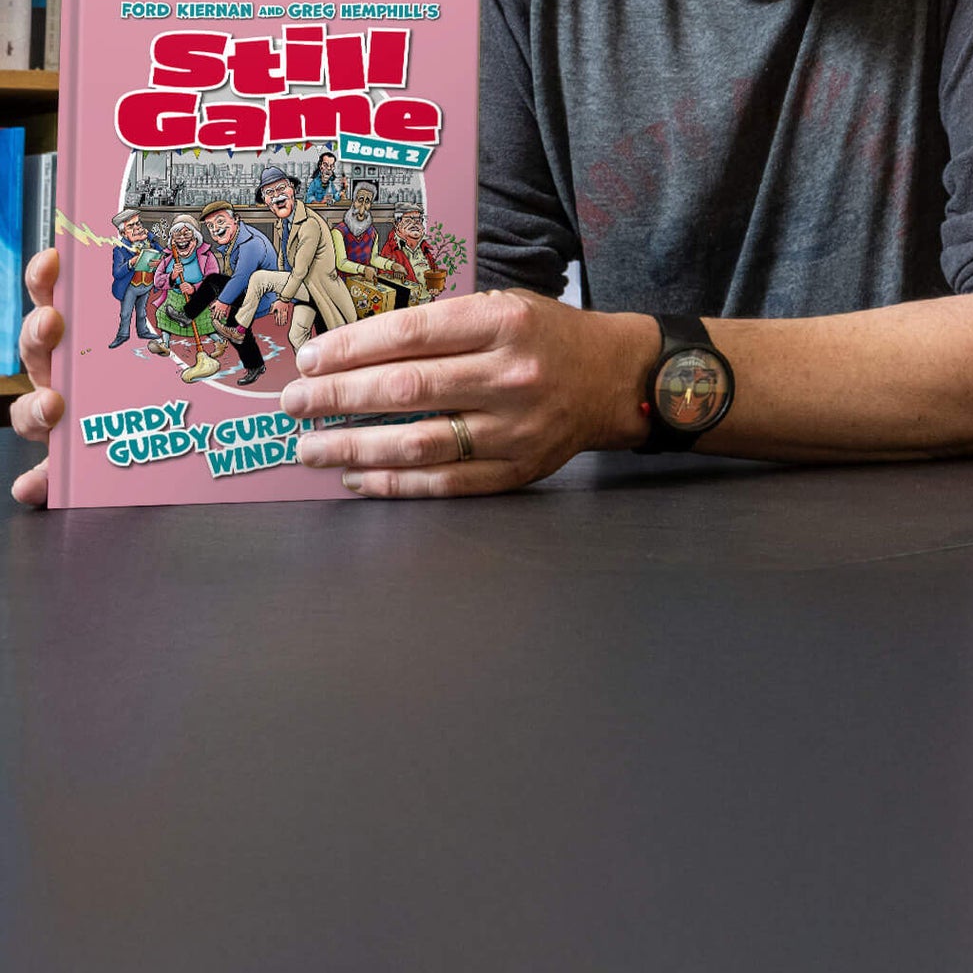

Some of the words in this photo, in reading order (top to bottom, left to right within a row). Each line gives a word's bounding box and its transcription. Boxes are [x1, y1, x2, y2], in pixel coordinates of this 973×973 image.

[121, 2, 171, 18] FORD
[177, 2, 252, 18] KIERNAN
[259, 6, 284, 16] AND
[287, 2, 335, 18] GREG
[341, 3, 440, 18] HEMPHILL'S
[150, 24, 409, 95] Still
[116, 91, 441, 149] Game
[346, 140, 400, 161] Book
[405, 148, 420, 163] 2
[82, 401, 187, 442] HURDY
[108, 425, 212, 465] GURDY
